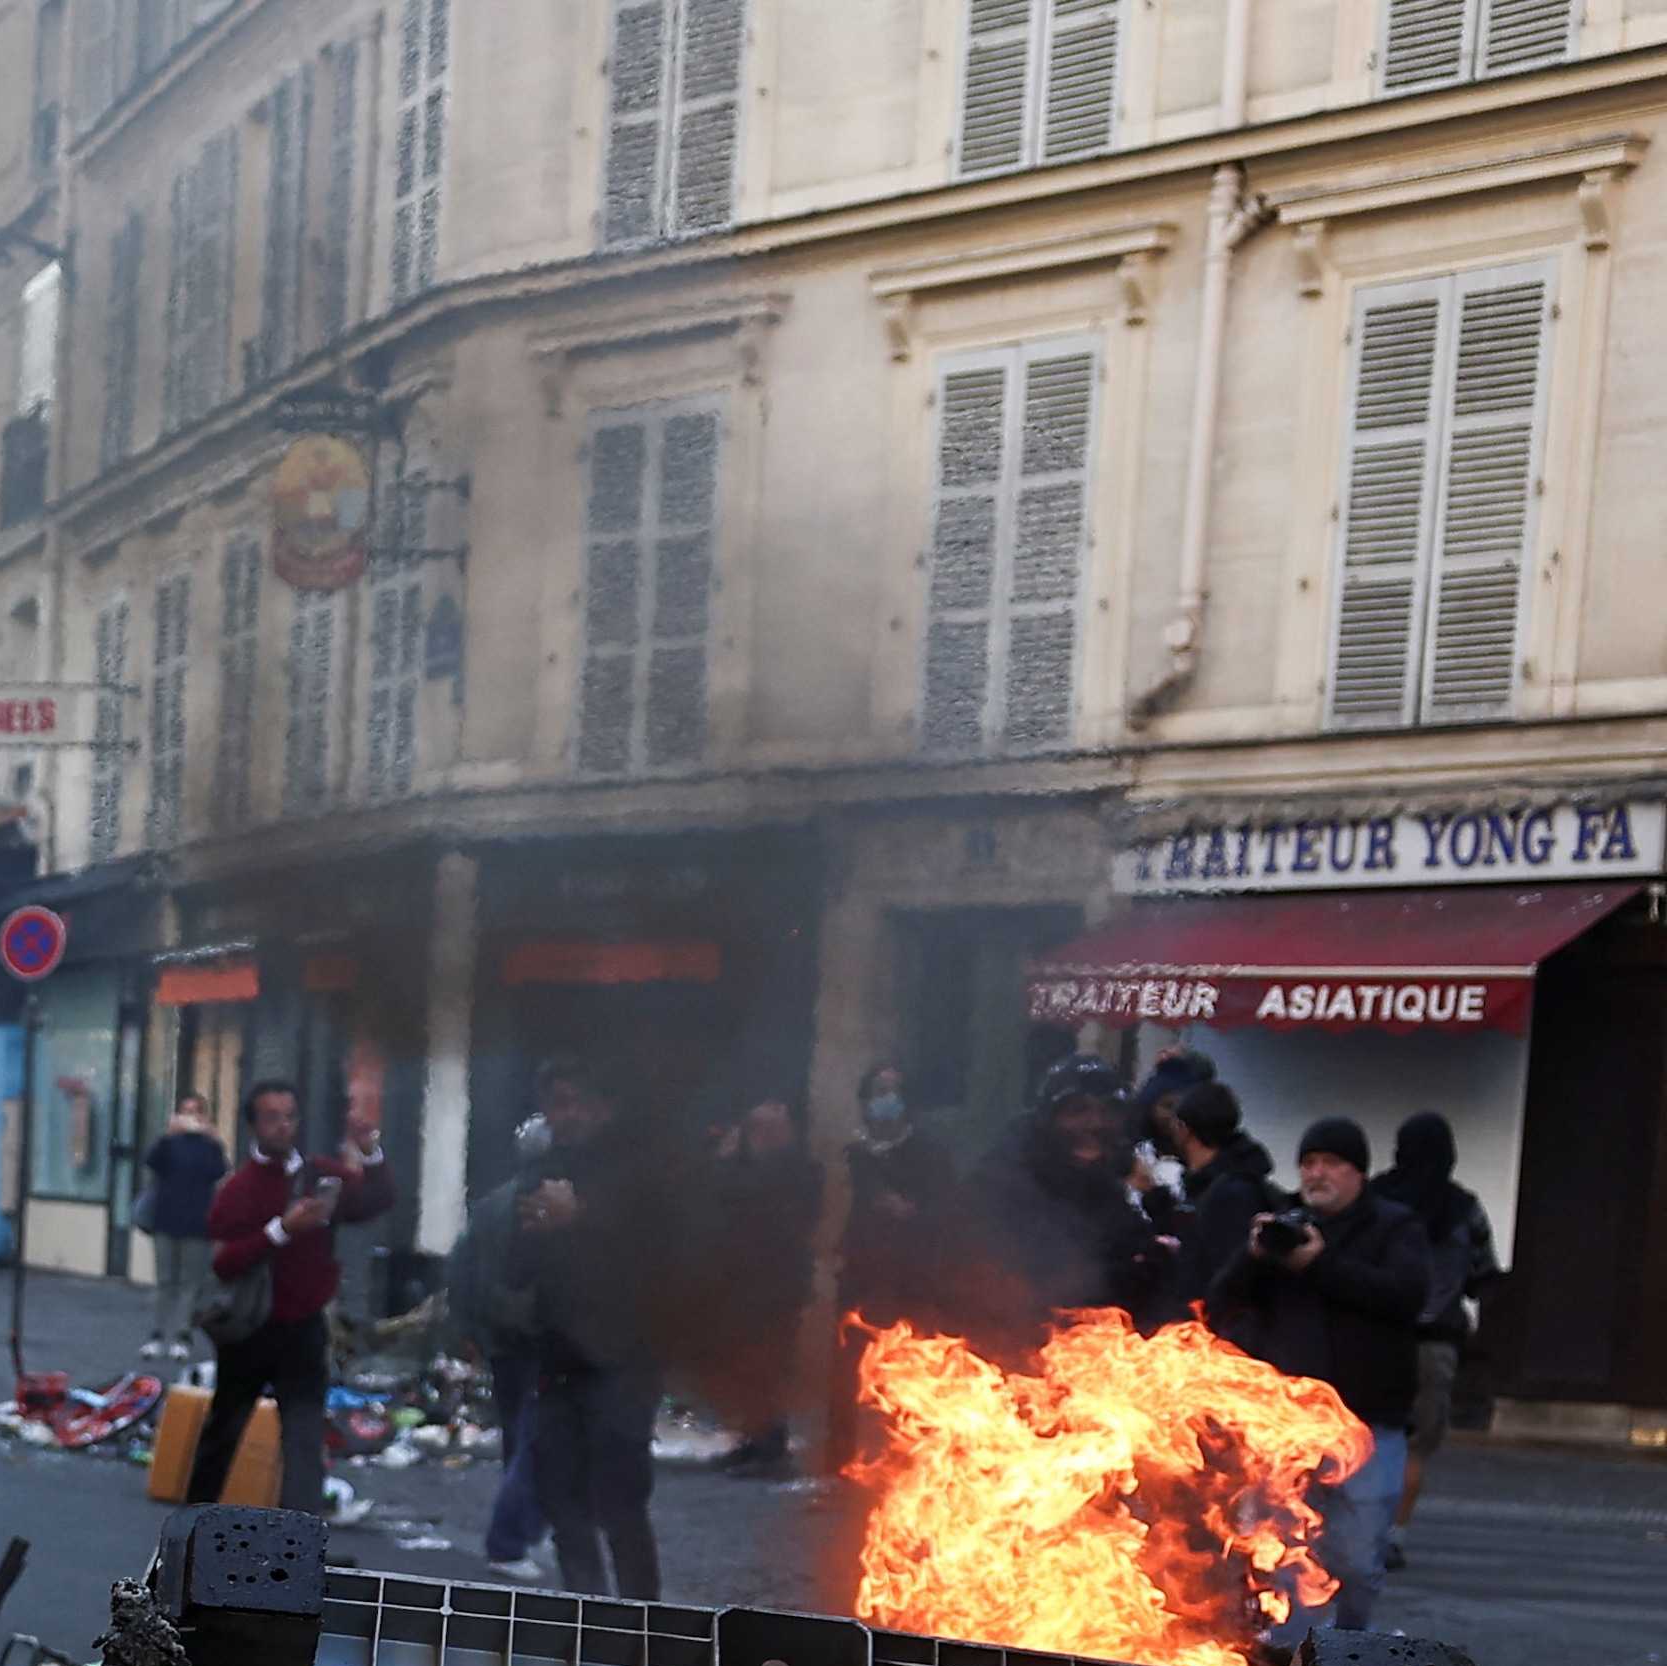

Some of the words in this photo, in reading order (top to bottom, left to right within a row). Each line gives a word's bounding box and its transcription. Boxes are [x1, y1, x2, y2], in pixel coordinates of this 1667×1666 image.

[1422, 809, 1557, 868] YONG
[1571, 804, 1638, 862] FA
[1029, 978, 1220, 1019] TRAITEUR
[1255, 984, 1488, 1022] ASIATIQUE
